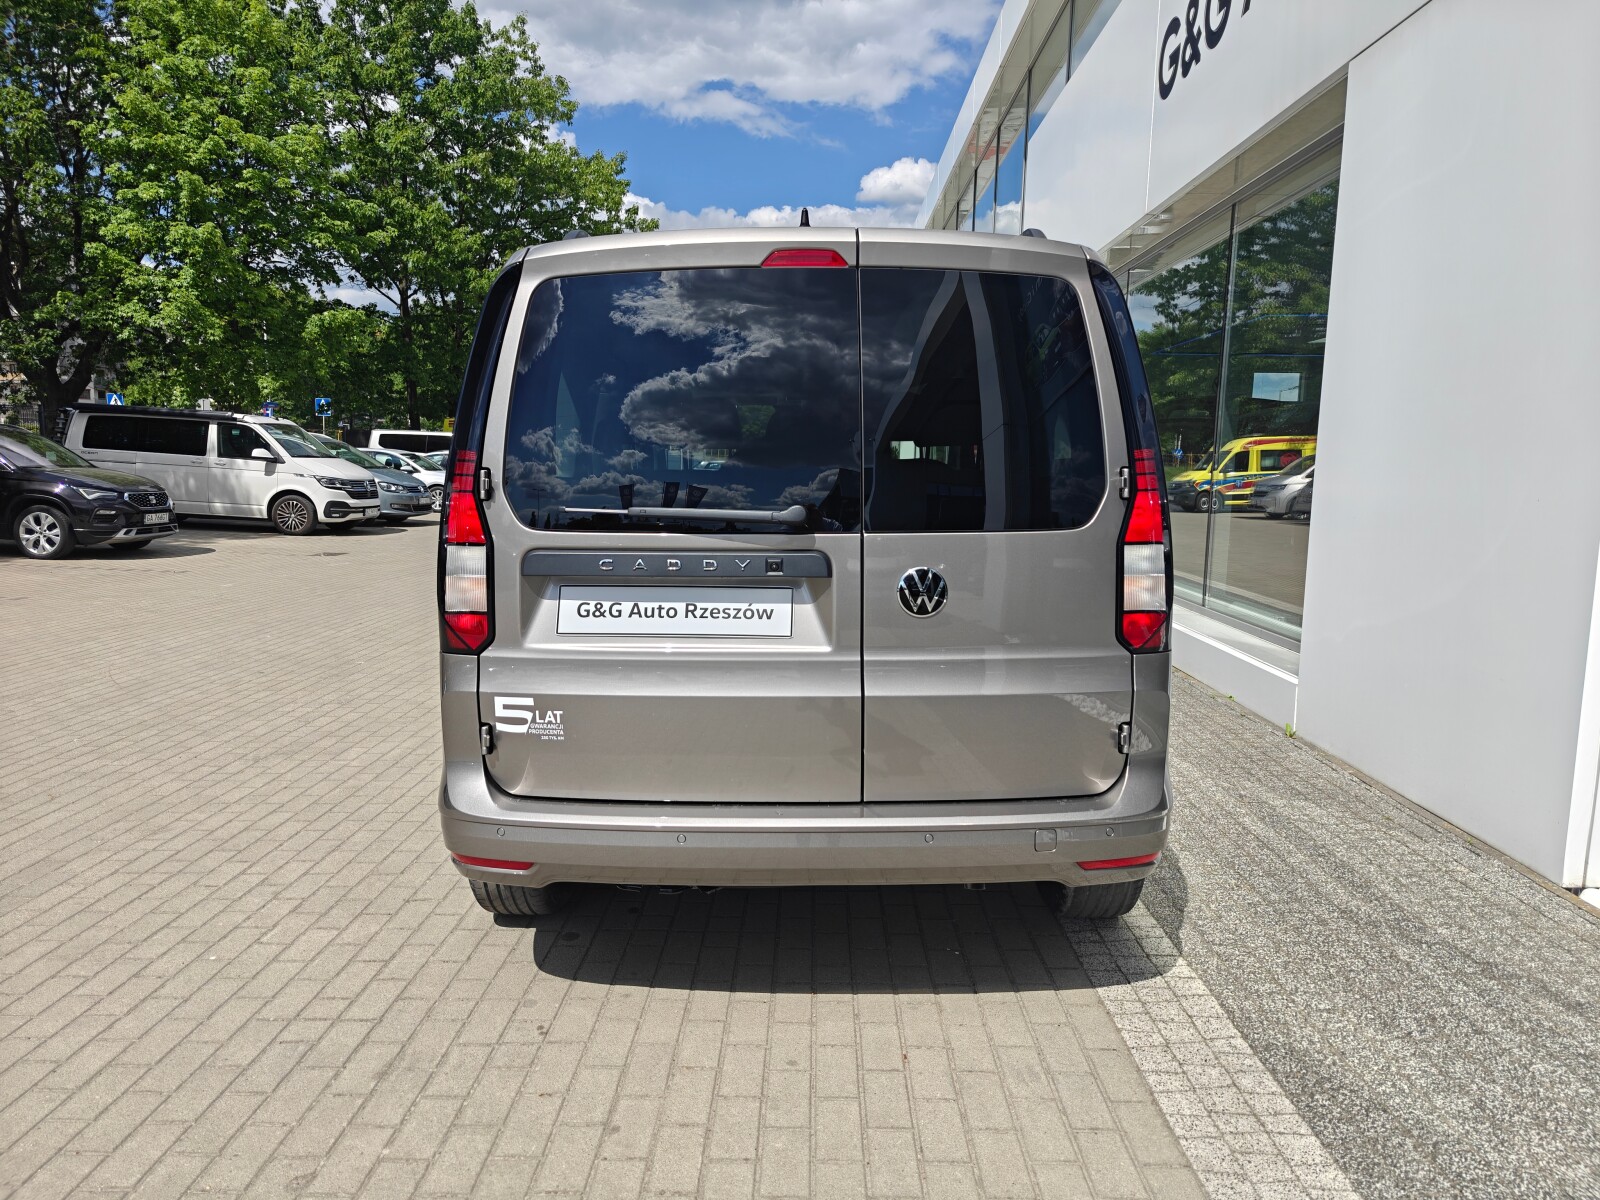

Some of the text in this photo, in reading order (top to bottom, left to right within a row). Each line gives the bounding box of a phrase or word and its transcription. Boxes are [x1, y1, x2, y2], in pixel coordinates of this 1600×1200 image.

[1158, 0, 1232, 100] G&G
[598, 558, 751, 571] CADDY
[576, 601, 775, 620] G&G Auto Rzeszów
[493, 696, 563, 734] 5 LAT
